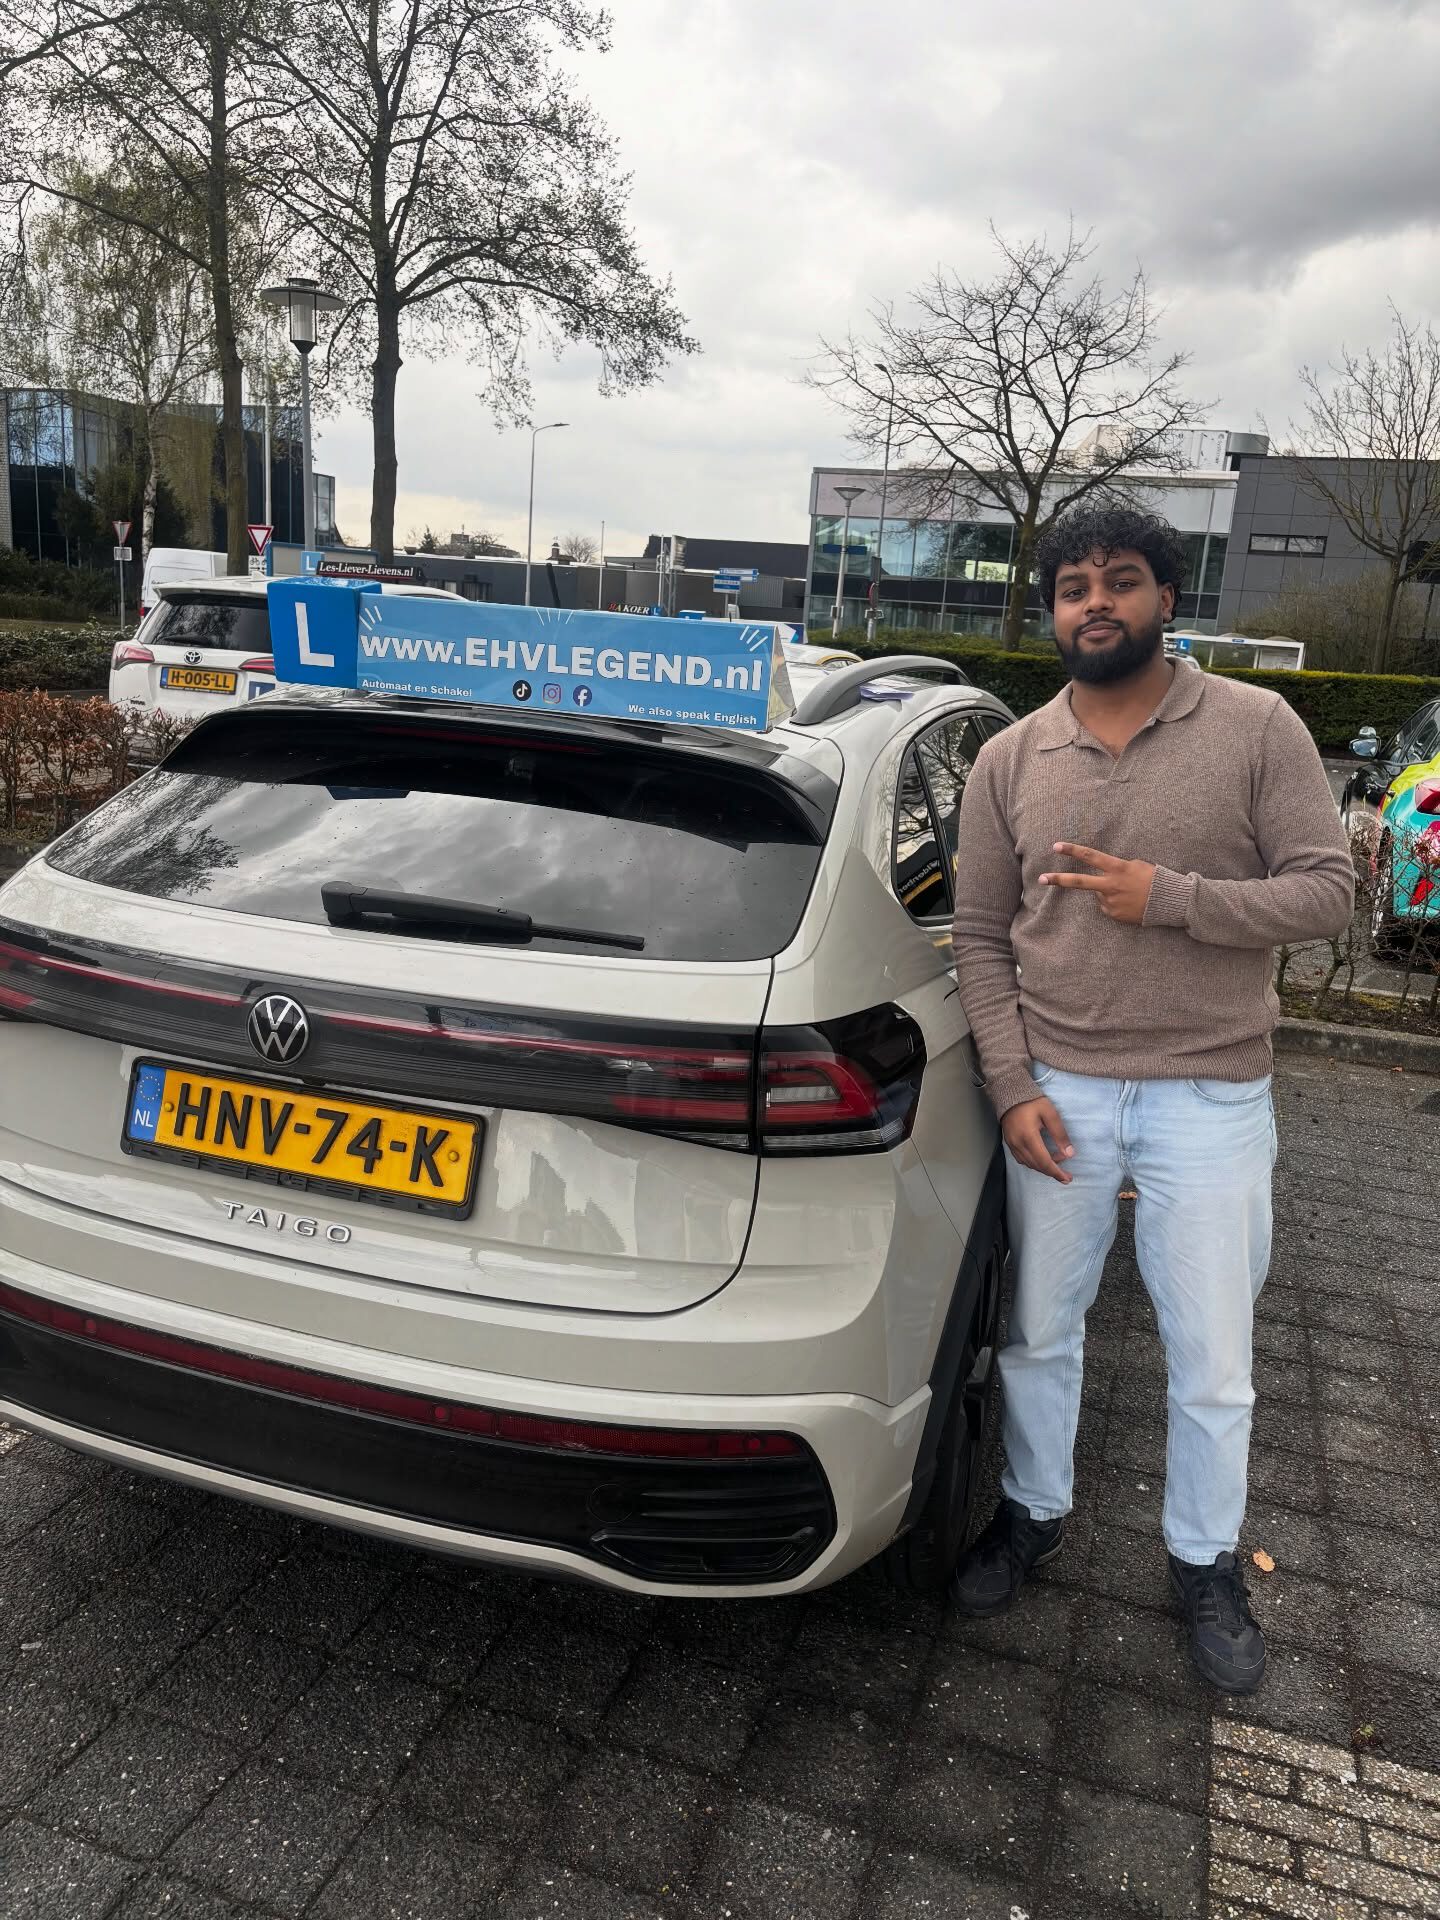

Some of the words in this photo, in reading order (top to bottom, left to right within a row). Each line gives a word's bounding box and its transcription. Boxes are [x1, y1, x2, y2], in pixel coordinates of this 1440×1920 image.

[319, 562, 414, 577] Les-Liever-Lievens.nl
[294, 602, 335, 668] L
[360, 634, 763, 692] www.EHVLEGEND.nl
[171, 670, 230, 689] H-005-LL
[362, 679, 412, 692] Automaat
[415, 685, 427, 693] en
[430, 685, 472, 697] Schakel
[628, 704, 645, 714] We
[648, 706, 673, 717] also
[675, 710, 711, 723] speak
[714, 712, 757, 725] English
[134, 1108, 154, 1128] NL
[173, 1082, 449, 1187] HNV-74-K
[223, 1201, 353, 1244] TAIGO
